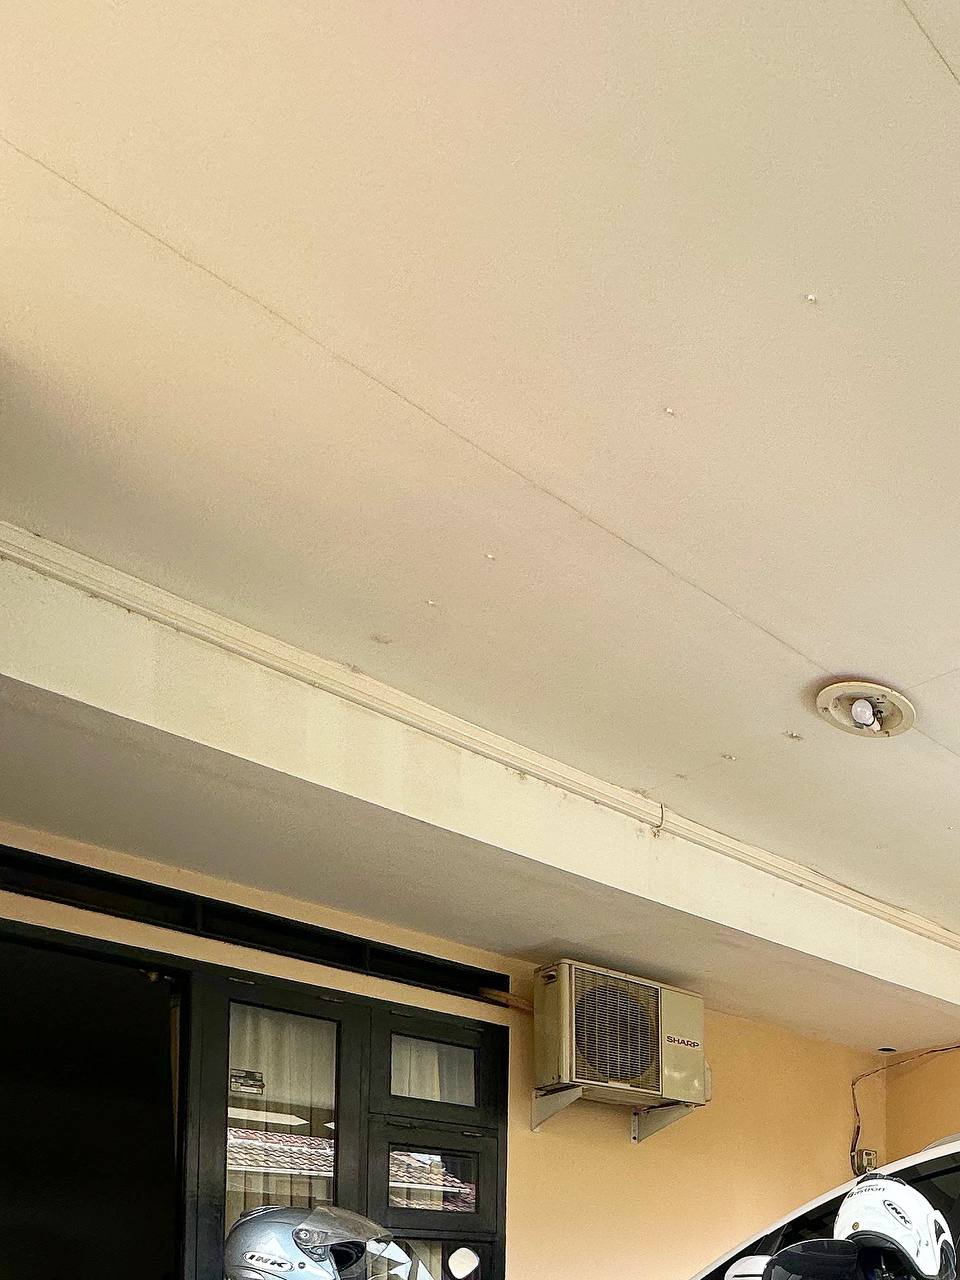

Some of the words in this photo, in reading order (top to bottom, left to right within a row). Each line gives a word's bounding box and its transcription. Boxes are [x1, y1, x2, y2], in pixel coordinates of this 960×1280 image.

[666, 1035, 700, 1048] SHARP
[886, 1202, 912, 1225] INK
[247, 1254, 289, 1269] INK
